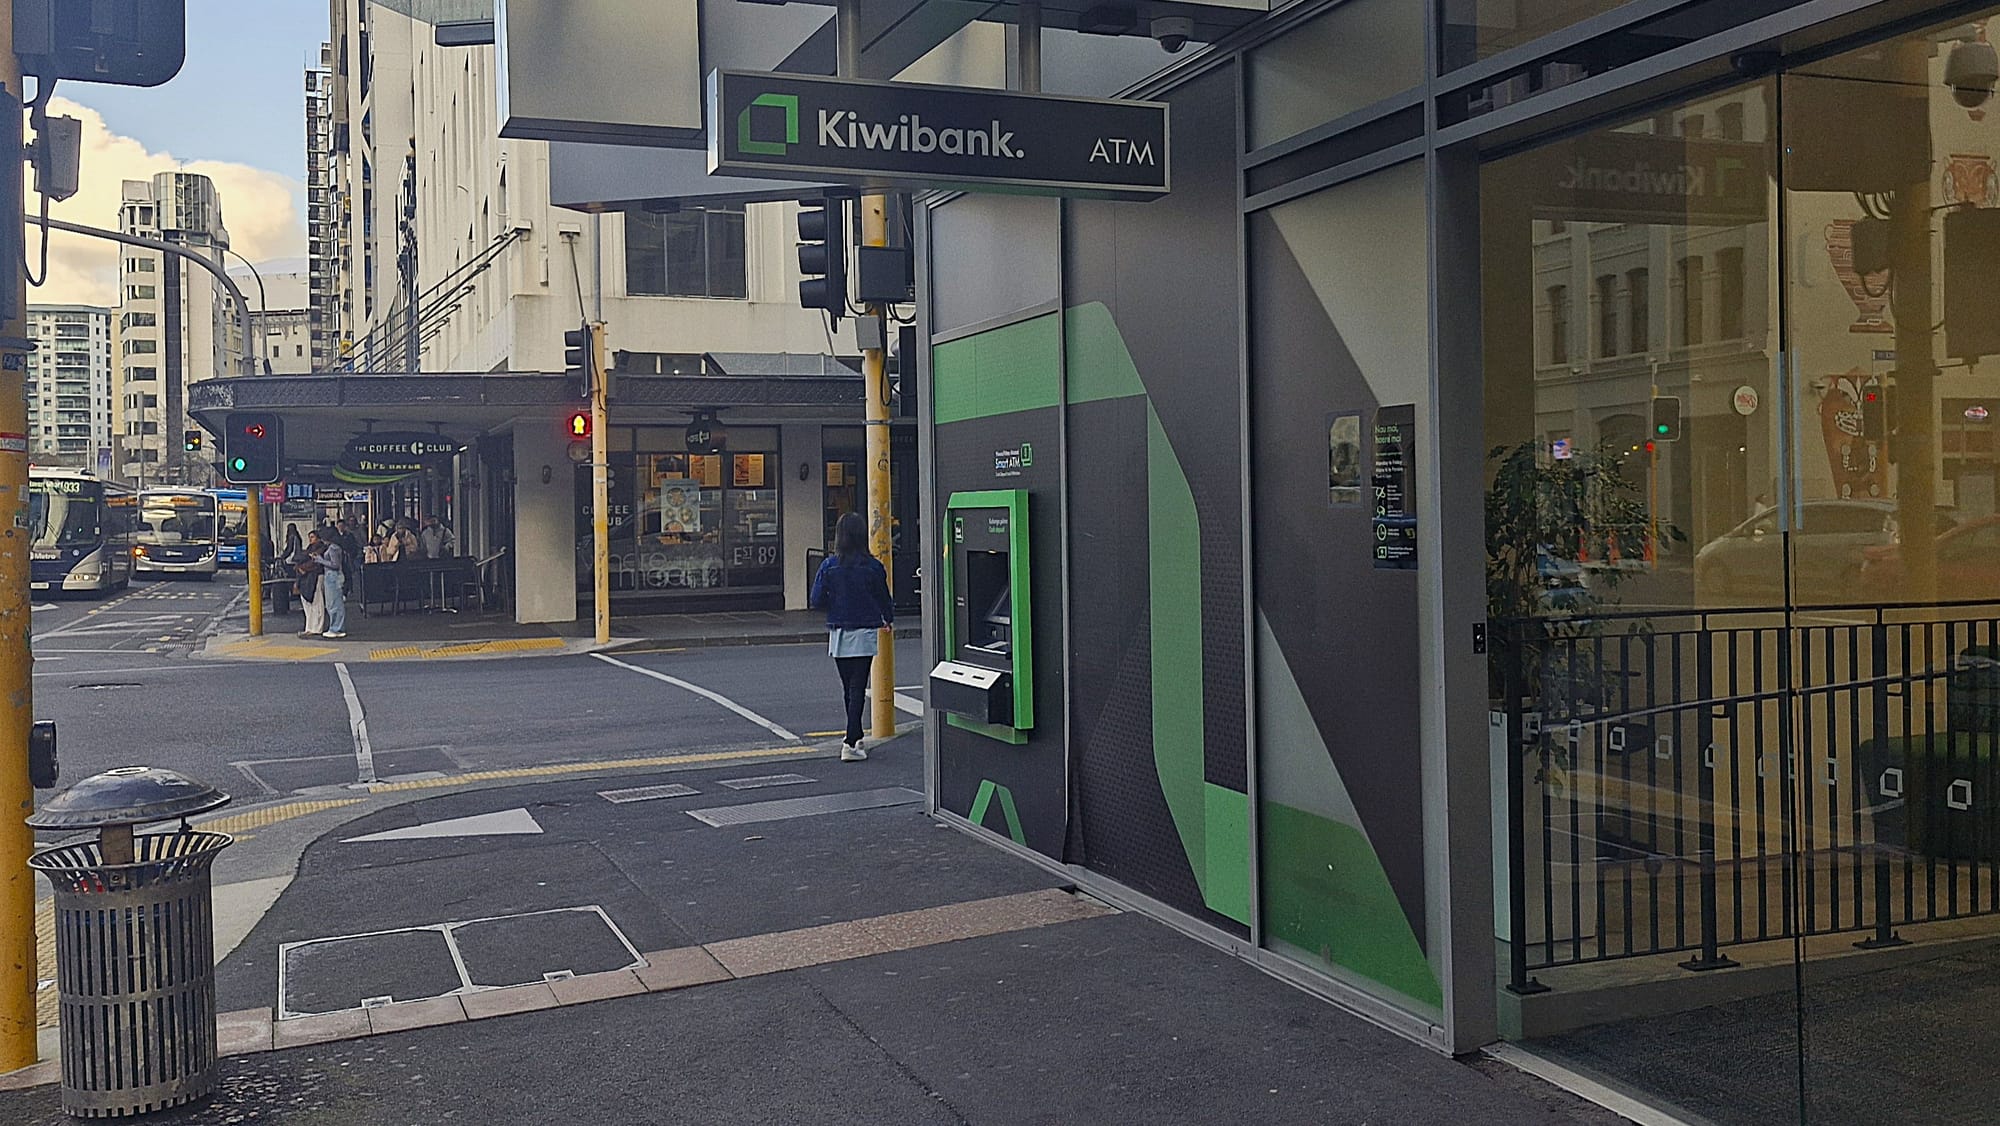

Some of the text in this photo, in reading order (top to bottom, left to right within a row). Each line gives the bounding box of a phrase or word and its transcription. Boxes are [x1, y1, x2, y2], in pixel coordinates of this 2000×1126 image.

[818, 109, 1025, 158] Kiwibank.
[1088, 138, 1154, 166] ATM
[63, 482, 80, 493] 933
[582, 505, 630, 515] CFEE
[34, 552, 57, 560] Metro
[758, 546, 777, 565] 89
